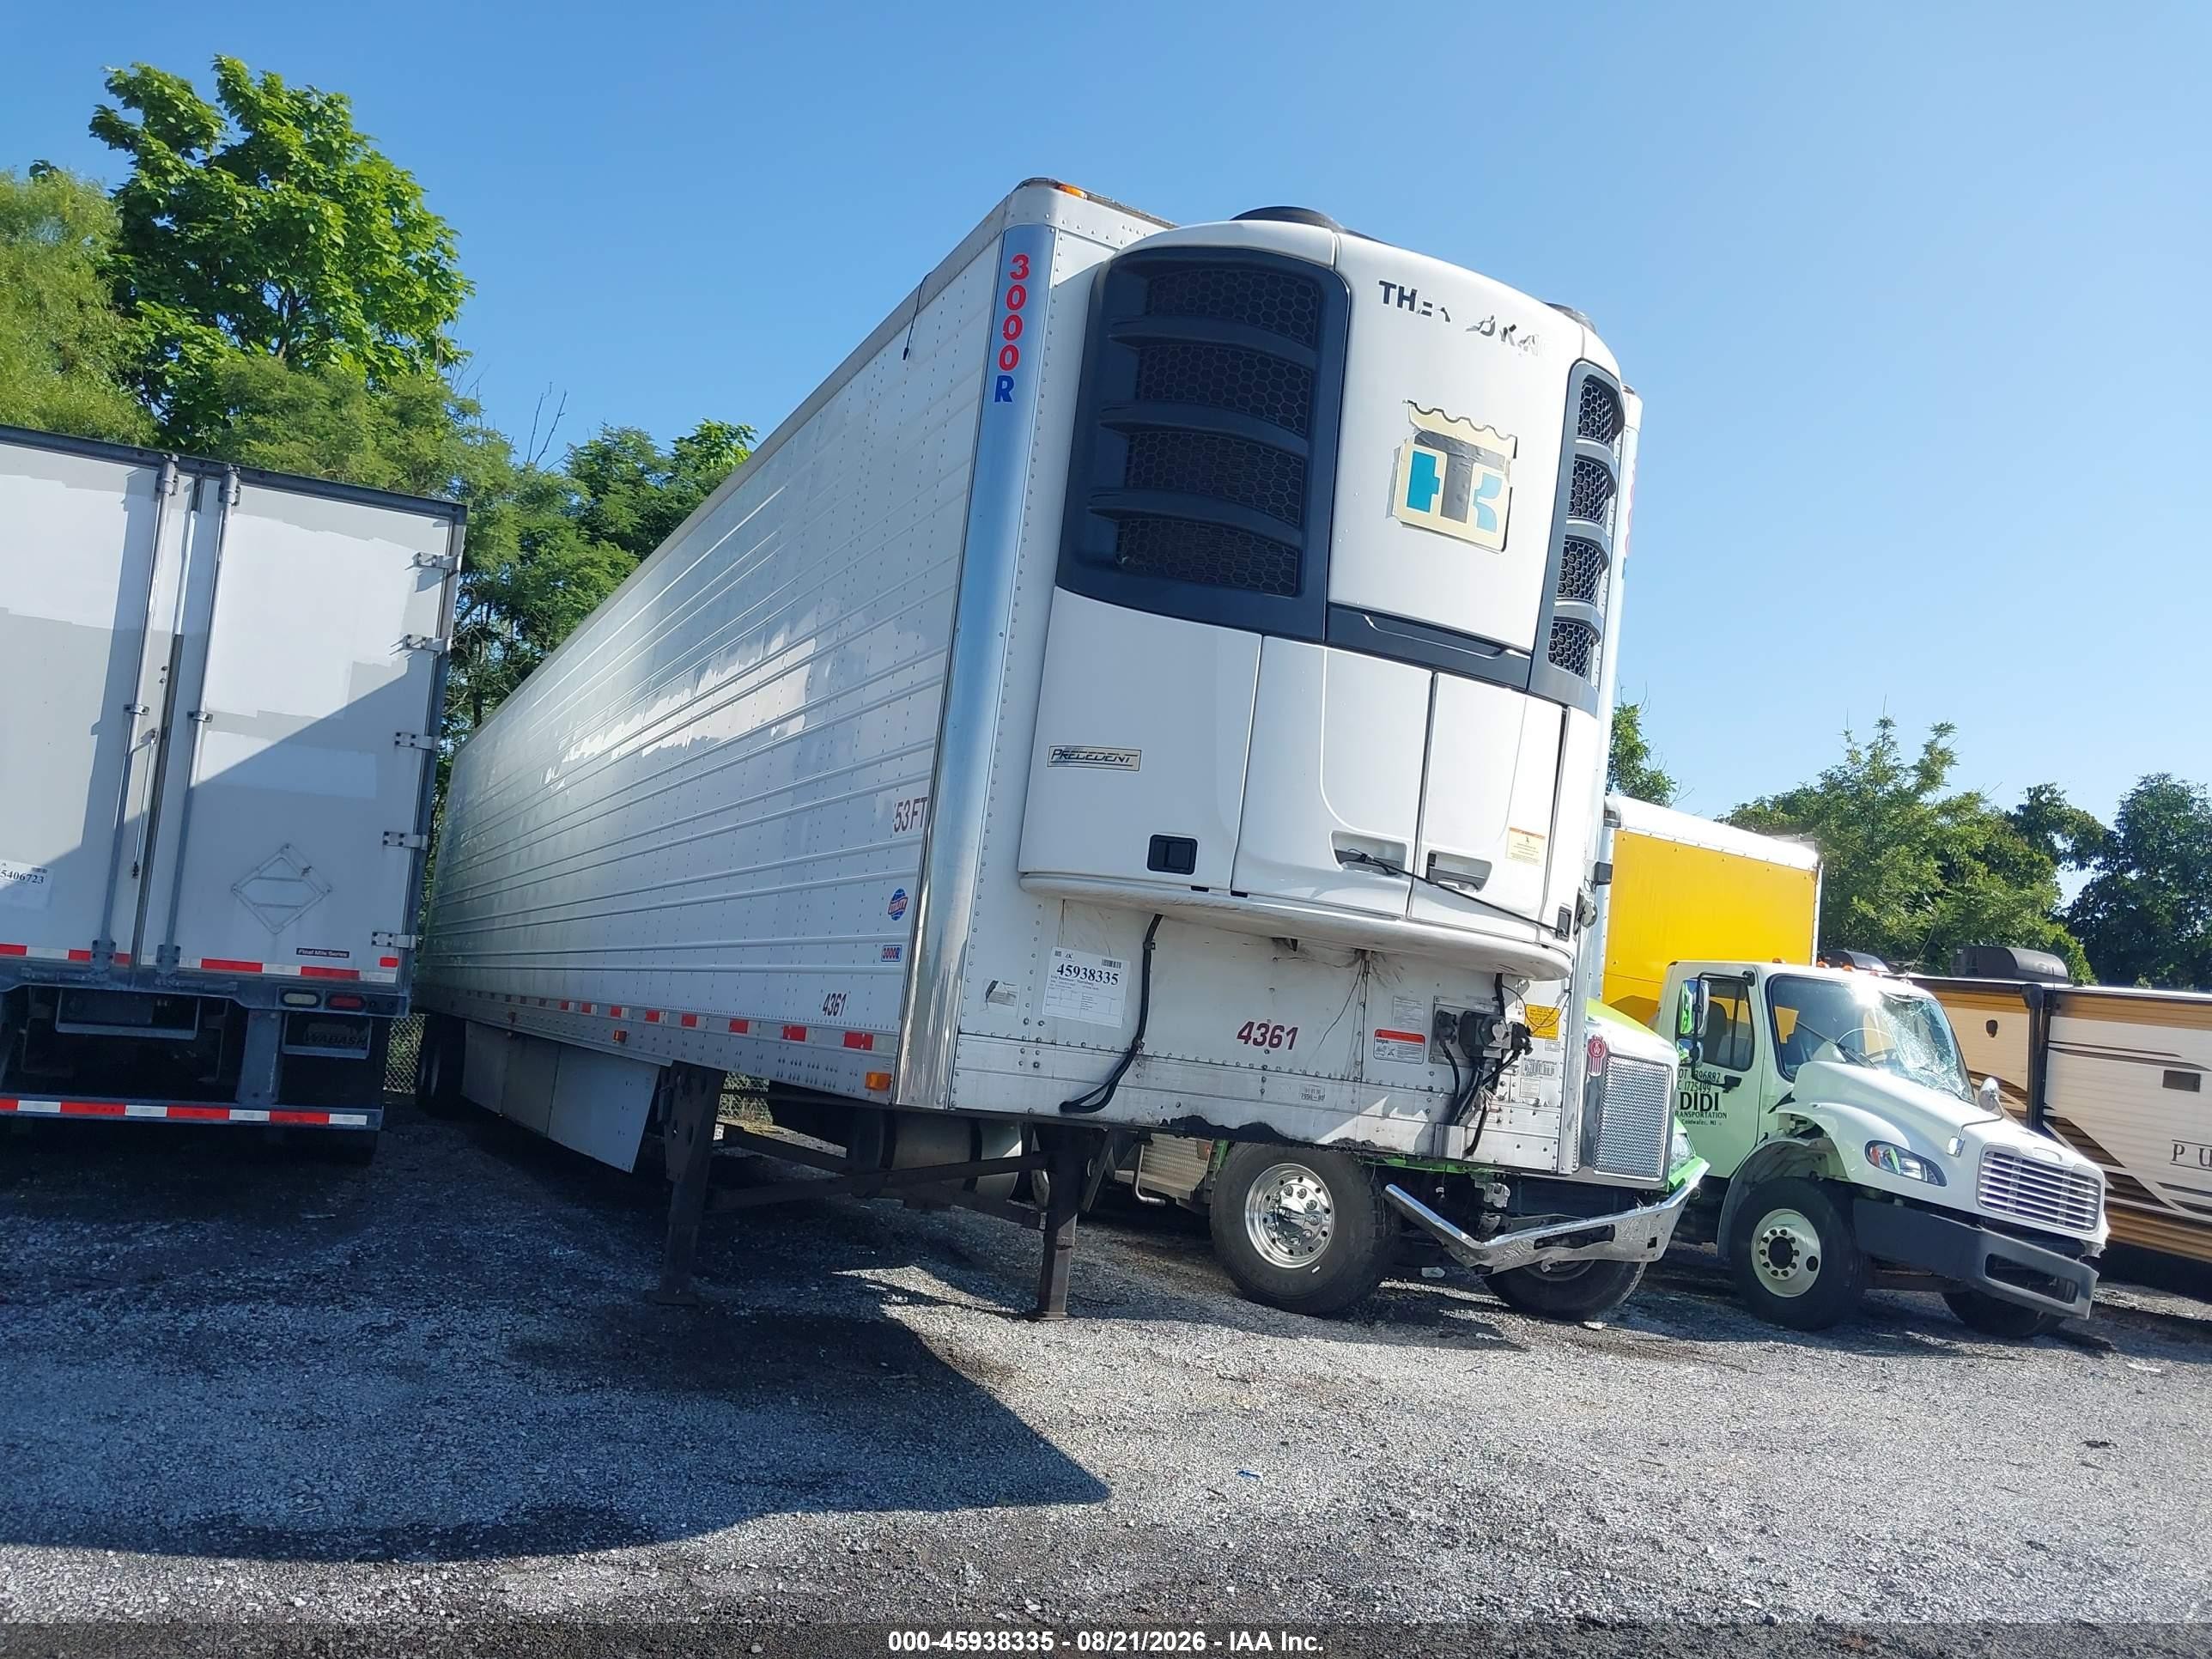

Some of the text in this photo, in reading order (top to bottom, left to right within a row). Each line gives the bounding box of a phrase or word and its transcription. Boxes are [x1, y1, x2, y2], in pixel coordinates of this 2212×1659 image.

[994, 253, 1030, 404] 3000R
[1051, 749, 1138, 763] PRECEDENT
[894, 796, 928, 833] 53FT
[0, 869, 45, 884] 5406723
[1056, 963, 1119, 986] 45938335
[823, 993, 847, 1017] 4361
[1237, 1021, 1298, 1050] 4361
[1694, 1070, 1721, 1083] 396882
[1680, 1091, 1719, 1112] DIDI
[1674, 1110, 1728, 1119] RANSPORTATION
